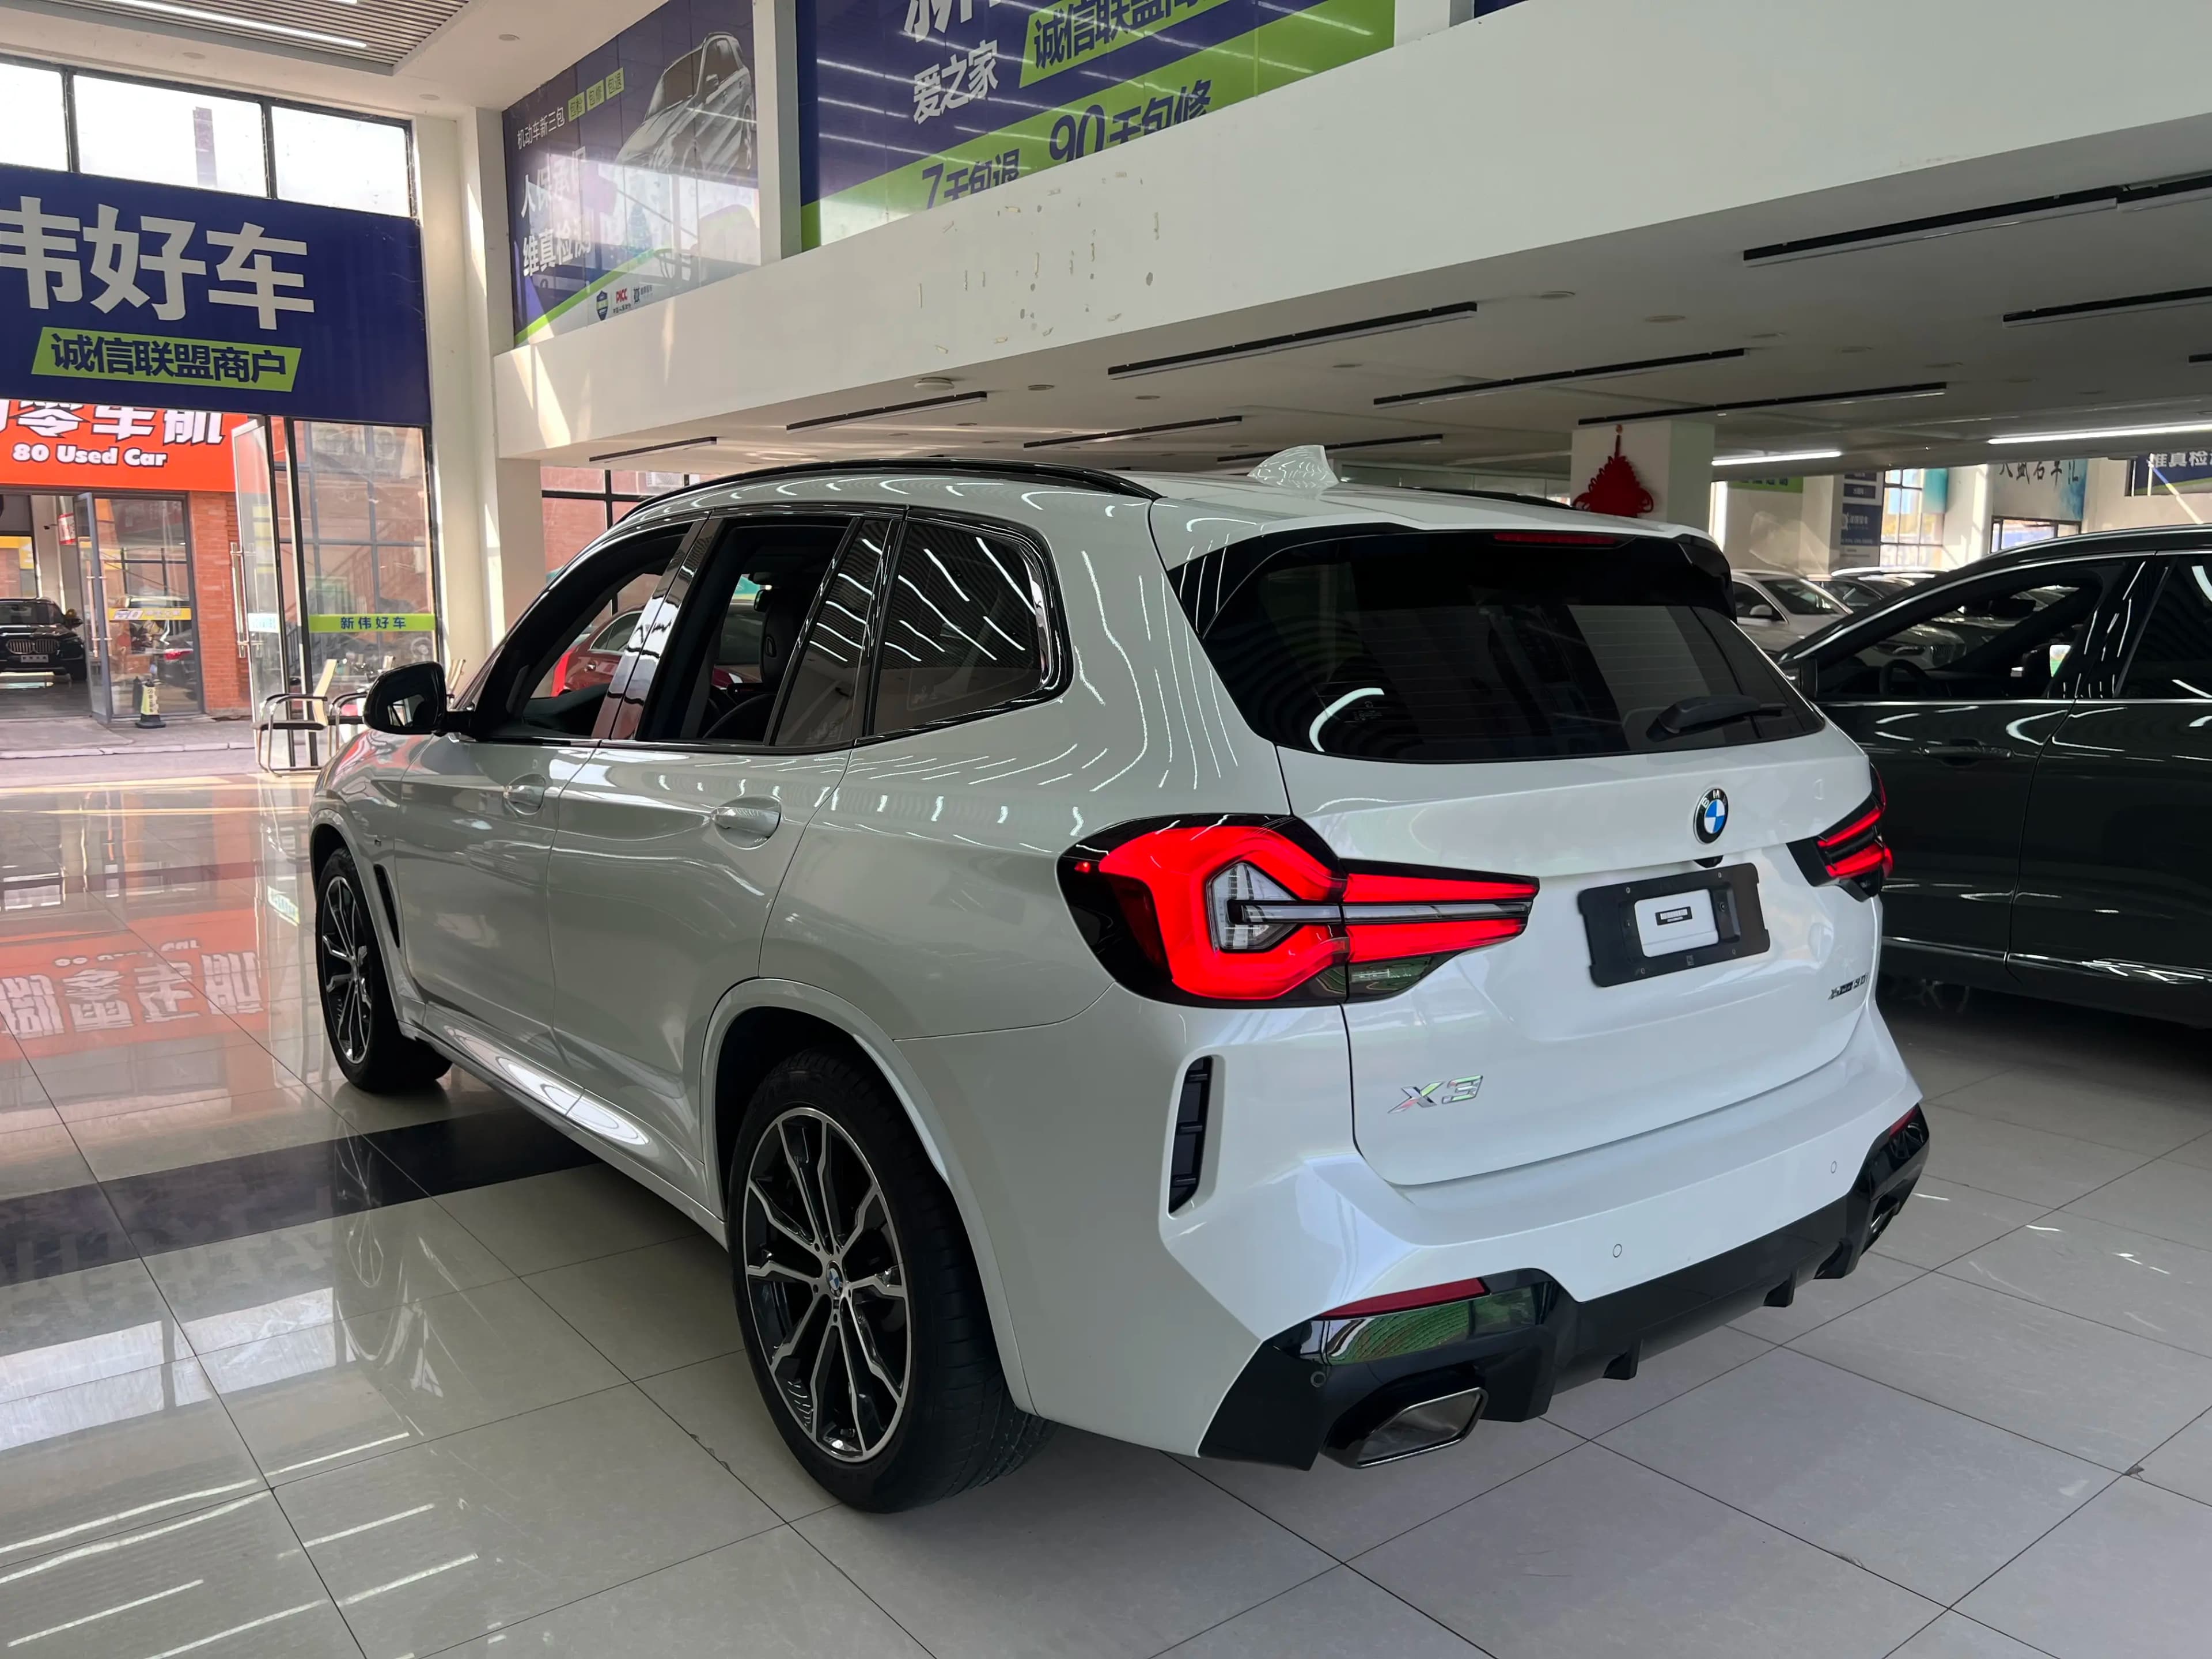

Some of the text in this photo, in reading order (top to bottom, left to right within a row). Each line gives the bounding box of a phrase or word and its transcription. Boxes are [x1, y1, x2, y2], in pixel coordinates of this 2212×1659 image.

[913, 39, 999, 124] 爱之家
[517, 107, 565, 150] 机动车新三包
[616, 288, 628, 304] PICC
[51, 334, 286, 383] 诚信联盟商户
[13, 444, 167, 467] 80 Used Car
[2148, 450, 2212, 468] 维真检
[340, 616, 407, 629] 新伟好车
[1387, 1075, 1484, 1113] X3
